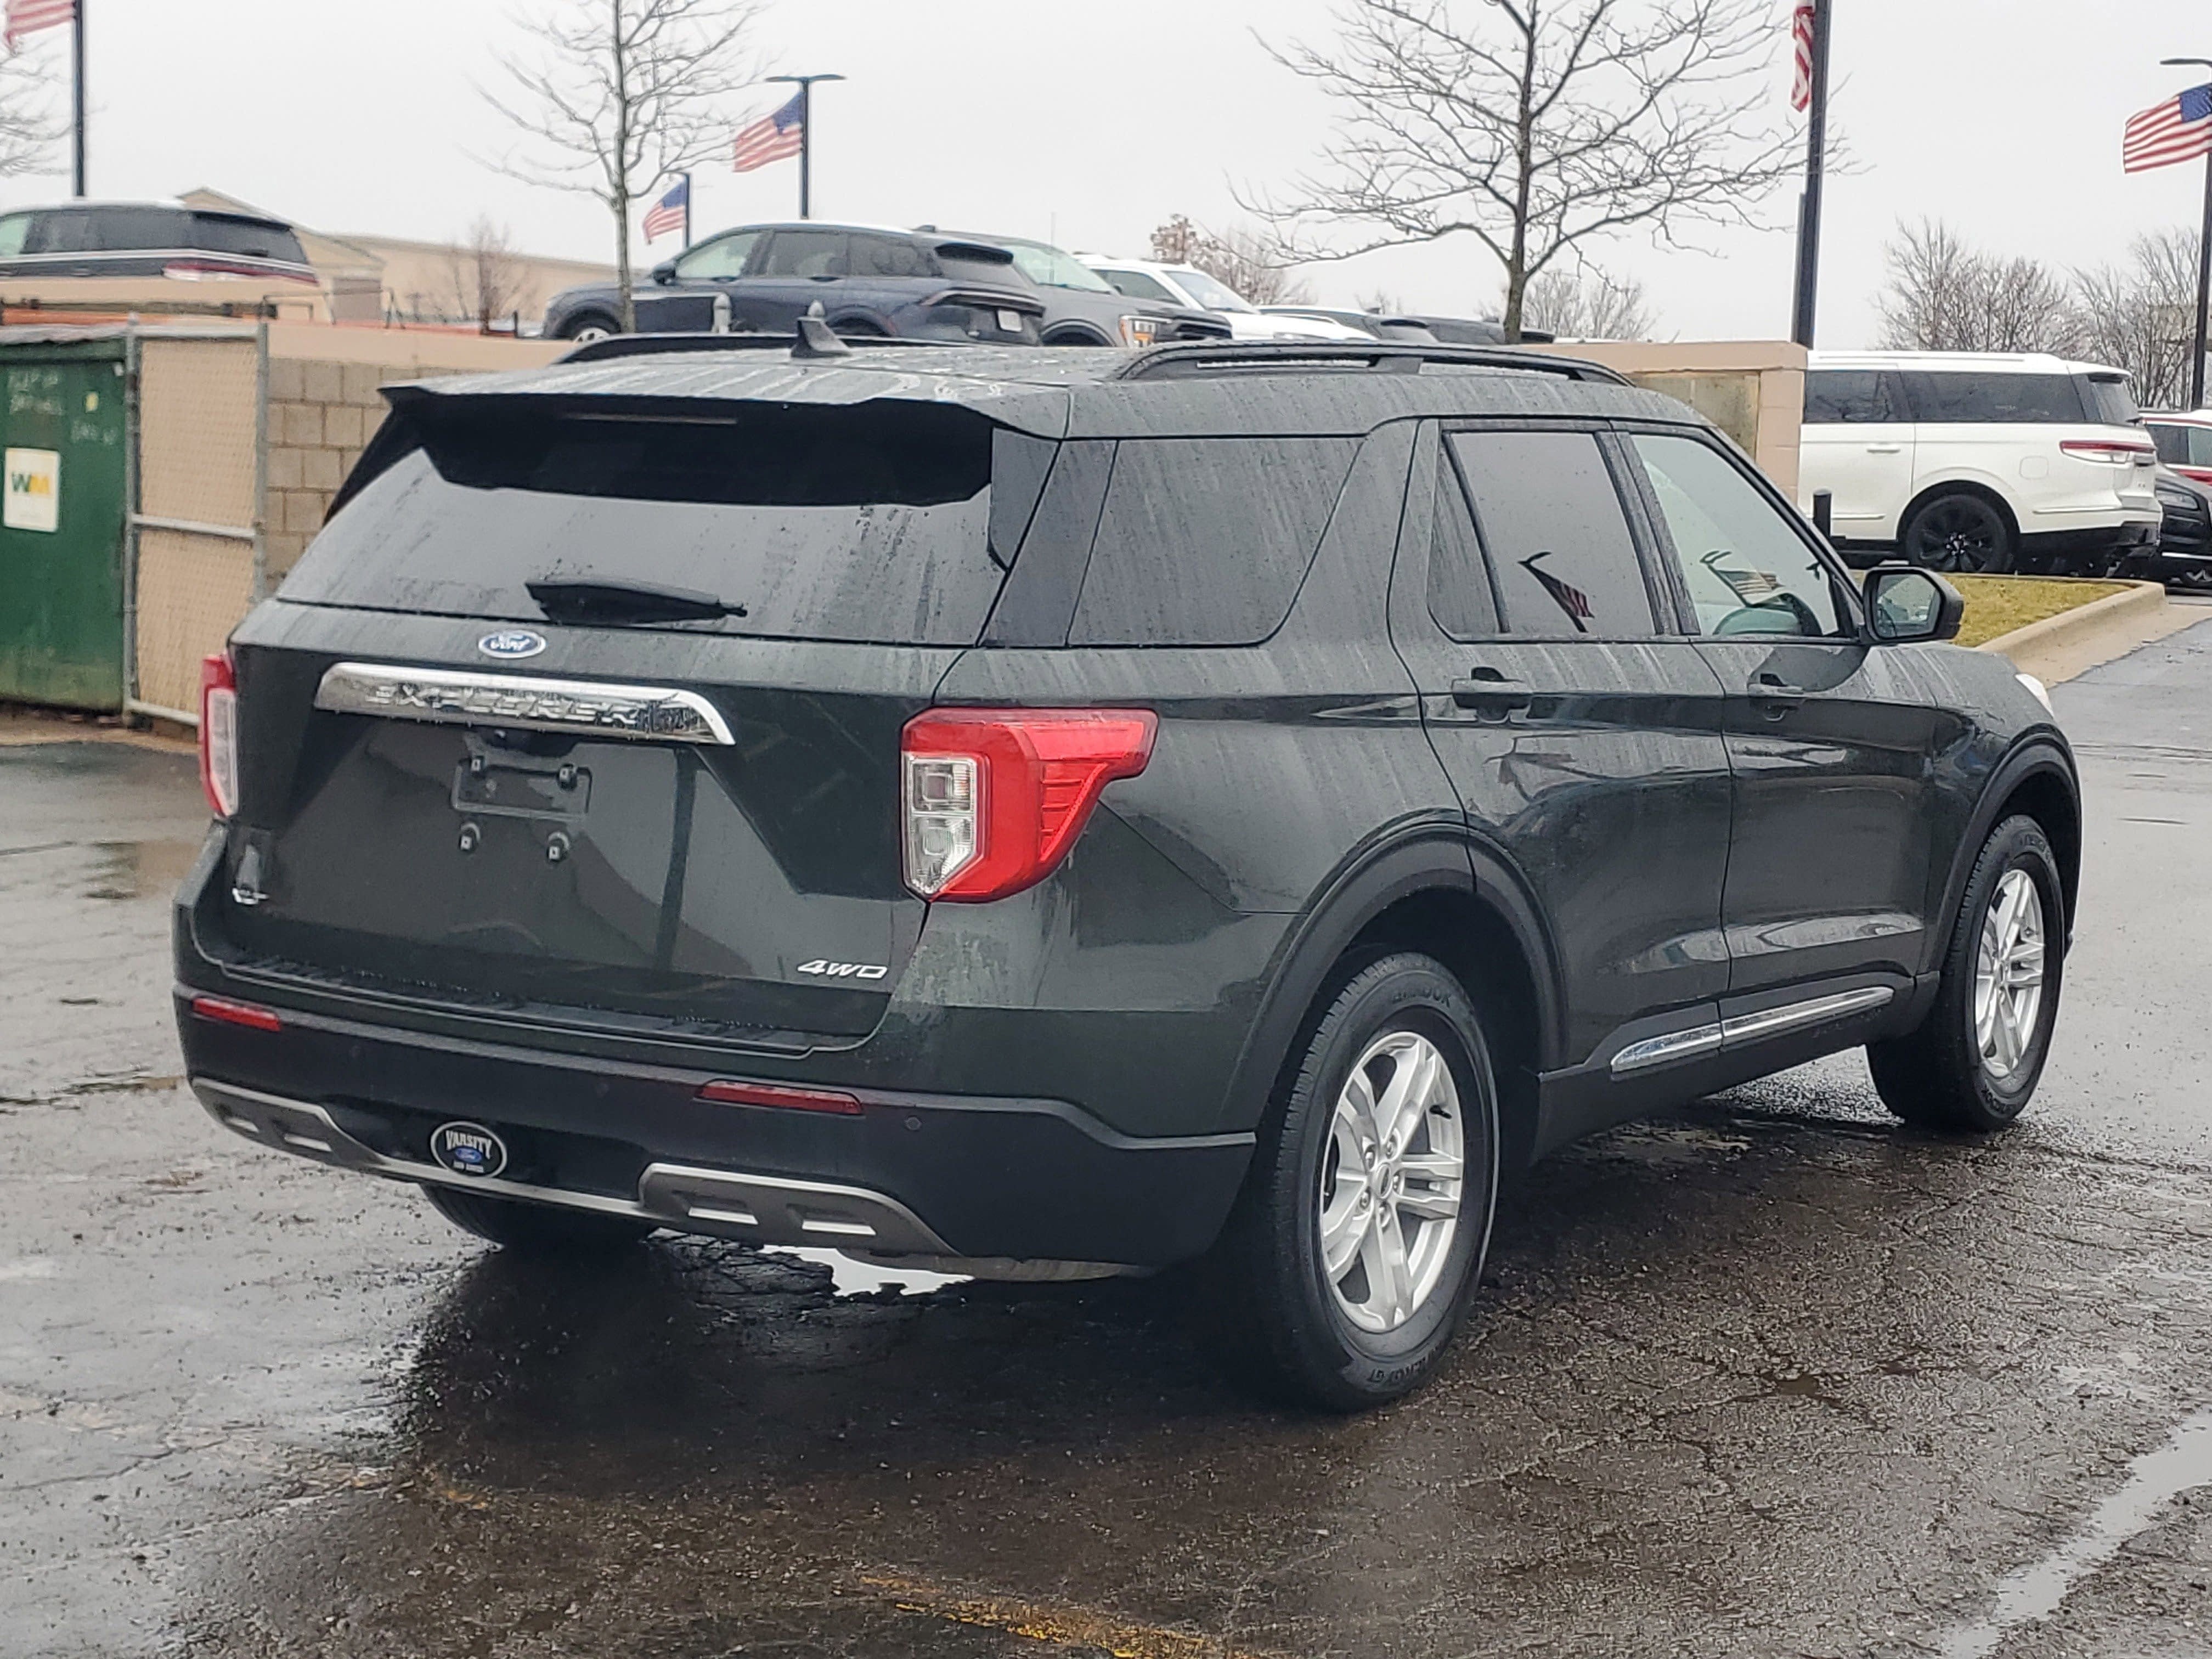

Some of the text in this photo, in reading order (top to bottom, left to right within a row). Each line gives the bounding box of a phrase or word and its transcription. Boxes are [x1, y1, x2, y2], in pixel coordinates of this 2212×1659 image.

[364, 684, 644, 725] EXPLORER
[797, 959, 888, 979] 4WD
[445, 1130, 493, 1160] VARSITY
